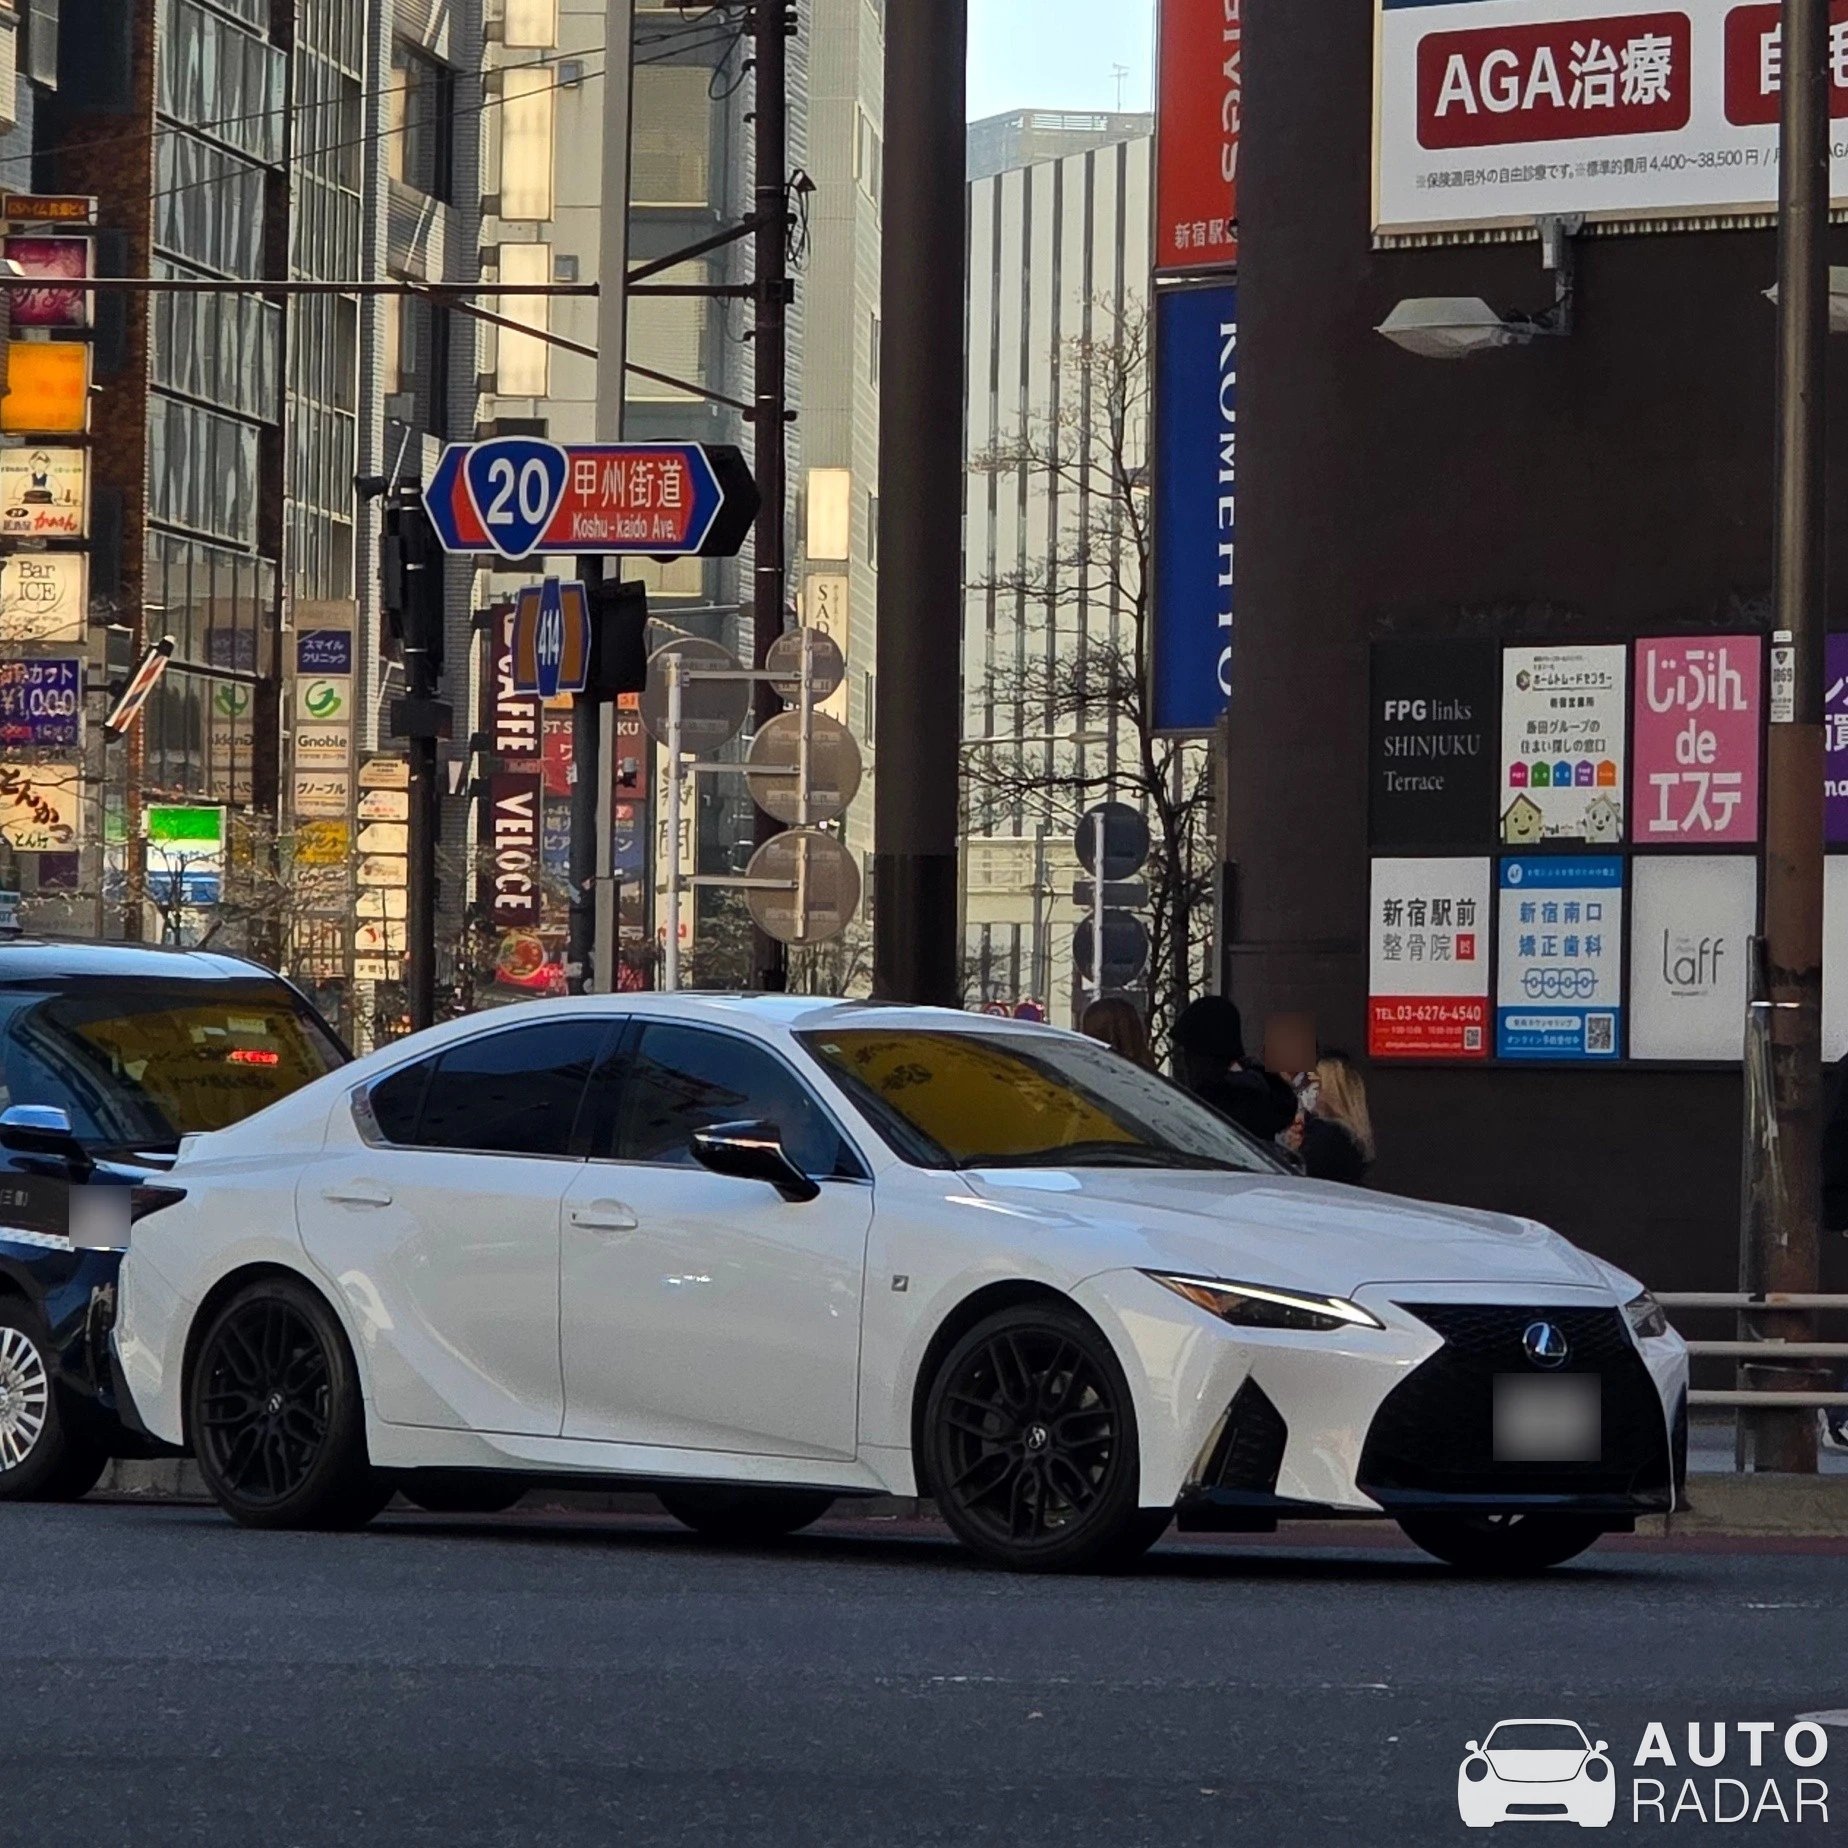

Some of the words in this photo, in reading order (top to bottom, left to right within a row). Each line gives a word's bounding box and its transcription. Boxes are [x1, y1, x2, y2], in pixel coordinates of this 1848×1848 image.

[1434, 33, 1673, 117] AGA治療
[487, 458, 549, 525] 20
[574, 459, 682, 508] 甲州街道
[19, 561, 55, 578] Bar
[19, 581, 55, 601] ICE
[304, 639, 344, 651] スマイル
[302, 653, 347, 664] クリニック
[1384, 699, 1427, 721] FPG
[1432, 698, 1472, 720] links
[298, 735, 347, 747] Gnoble
[1384, 734, 1481, 760] SHINJUKU
[1675, 718, 1717, 764] de
[297, 783, 346, 795] グノーブル
[1383, 770, 1444, 791] Terrace
[1649, 772, 1742, 831] エステ
[495, 791, 533, 909] VELOCE
[1383, 898, 1476, 927] 新宿駅前
[1520, 901, 1602, 924] 新宿南口
[1383, 933, 1451, 961] 整骨院
[1519, 934, 1602, 958] 矯正歯科
[1663, 928, 1724, 985] laff
